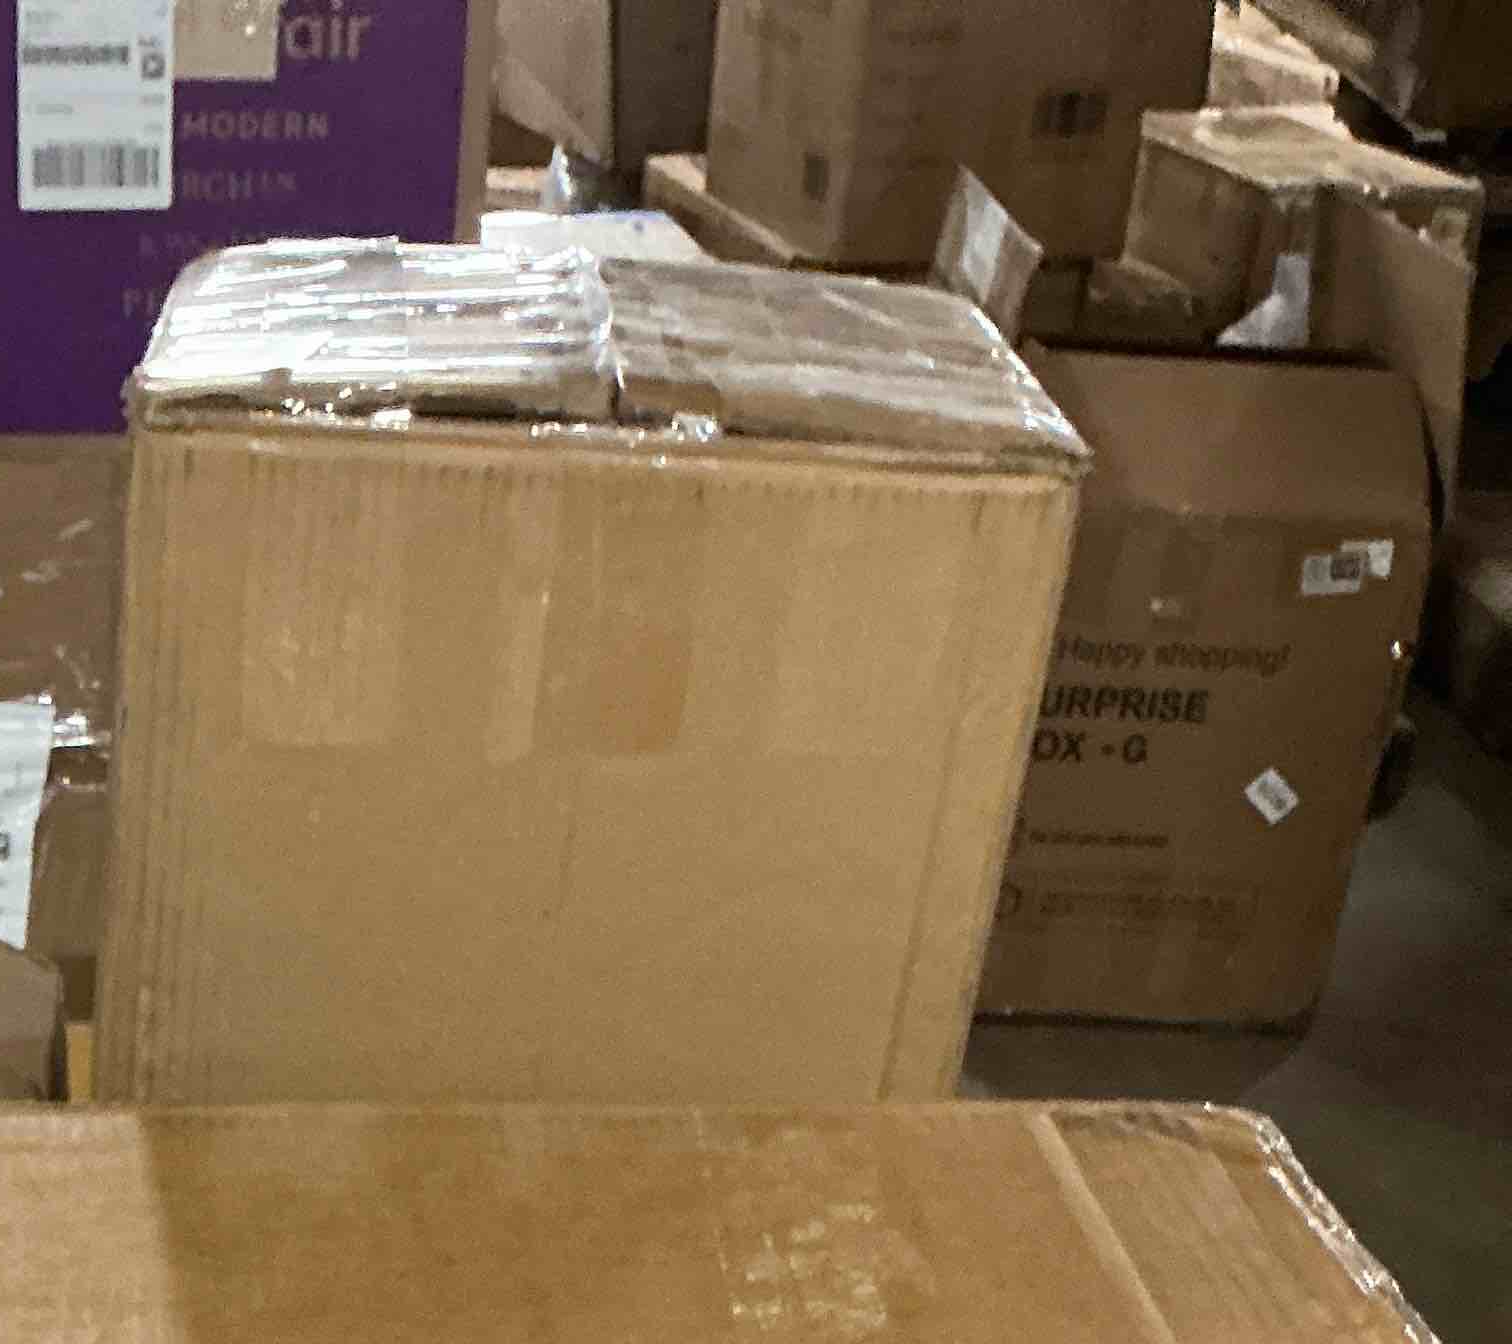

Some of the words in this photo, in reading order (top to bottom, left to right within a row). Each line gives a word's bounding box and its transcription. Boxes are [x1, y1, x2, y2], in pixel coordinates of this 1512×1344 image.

[284, 0, 370, 60] air
[1037, 685, 1208, 723] URPRISE
[1031, 728, 1085, 764] OX
